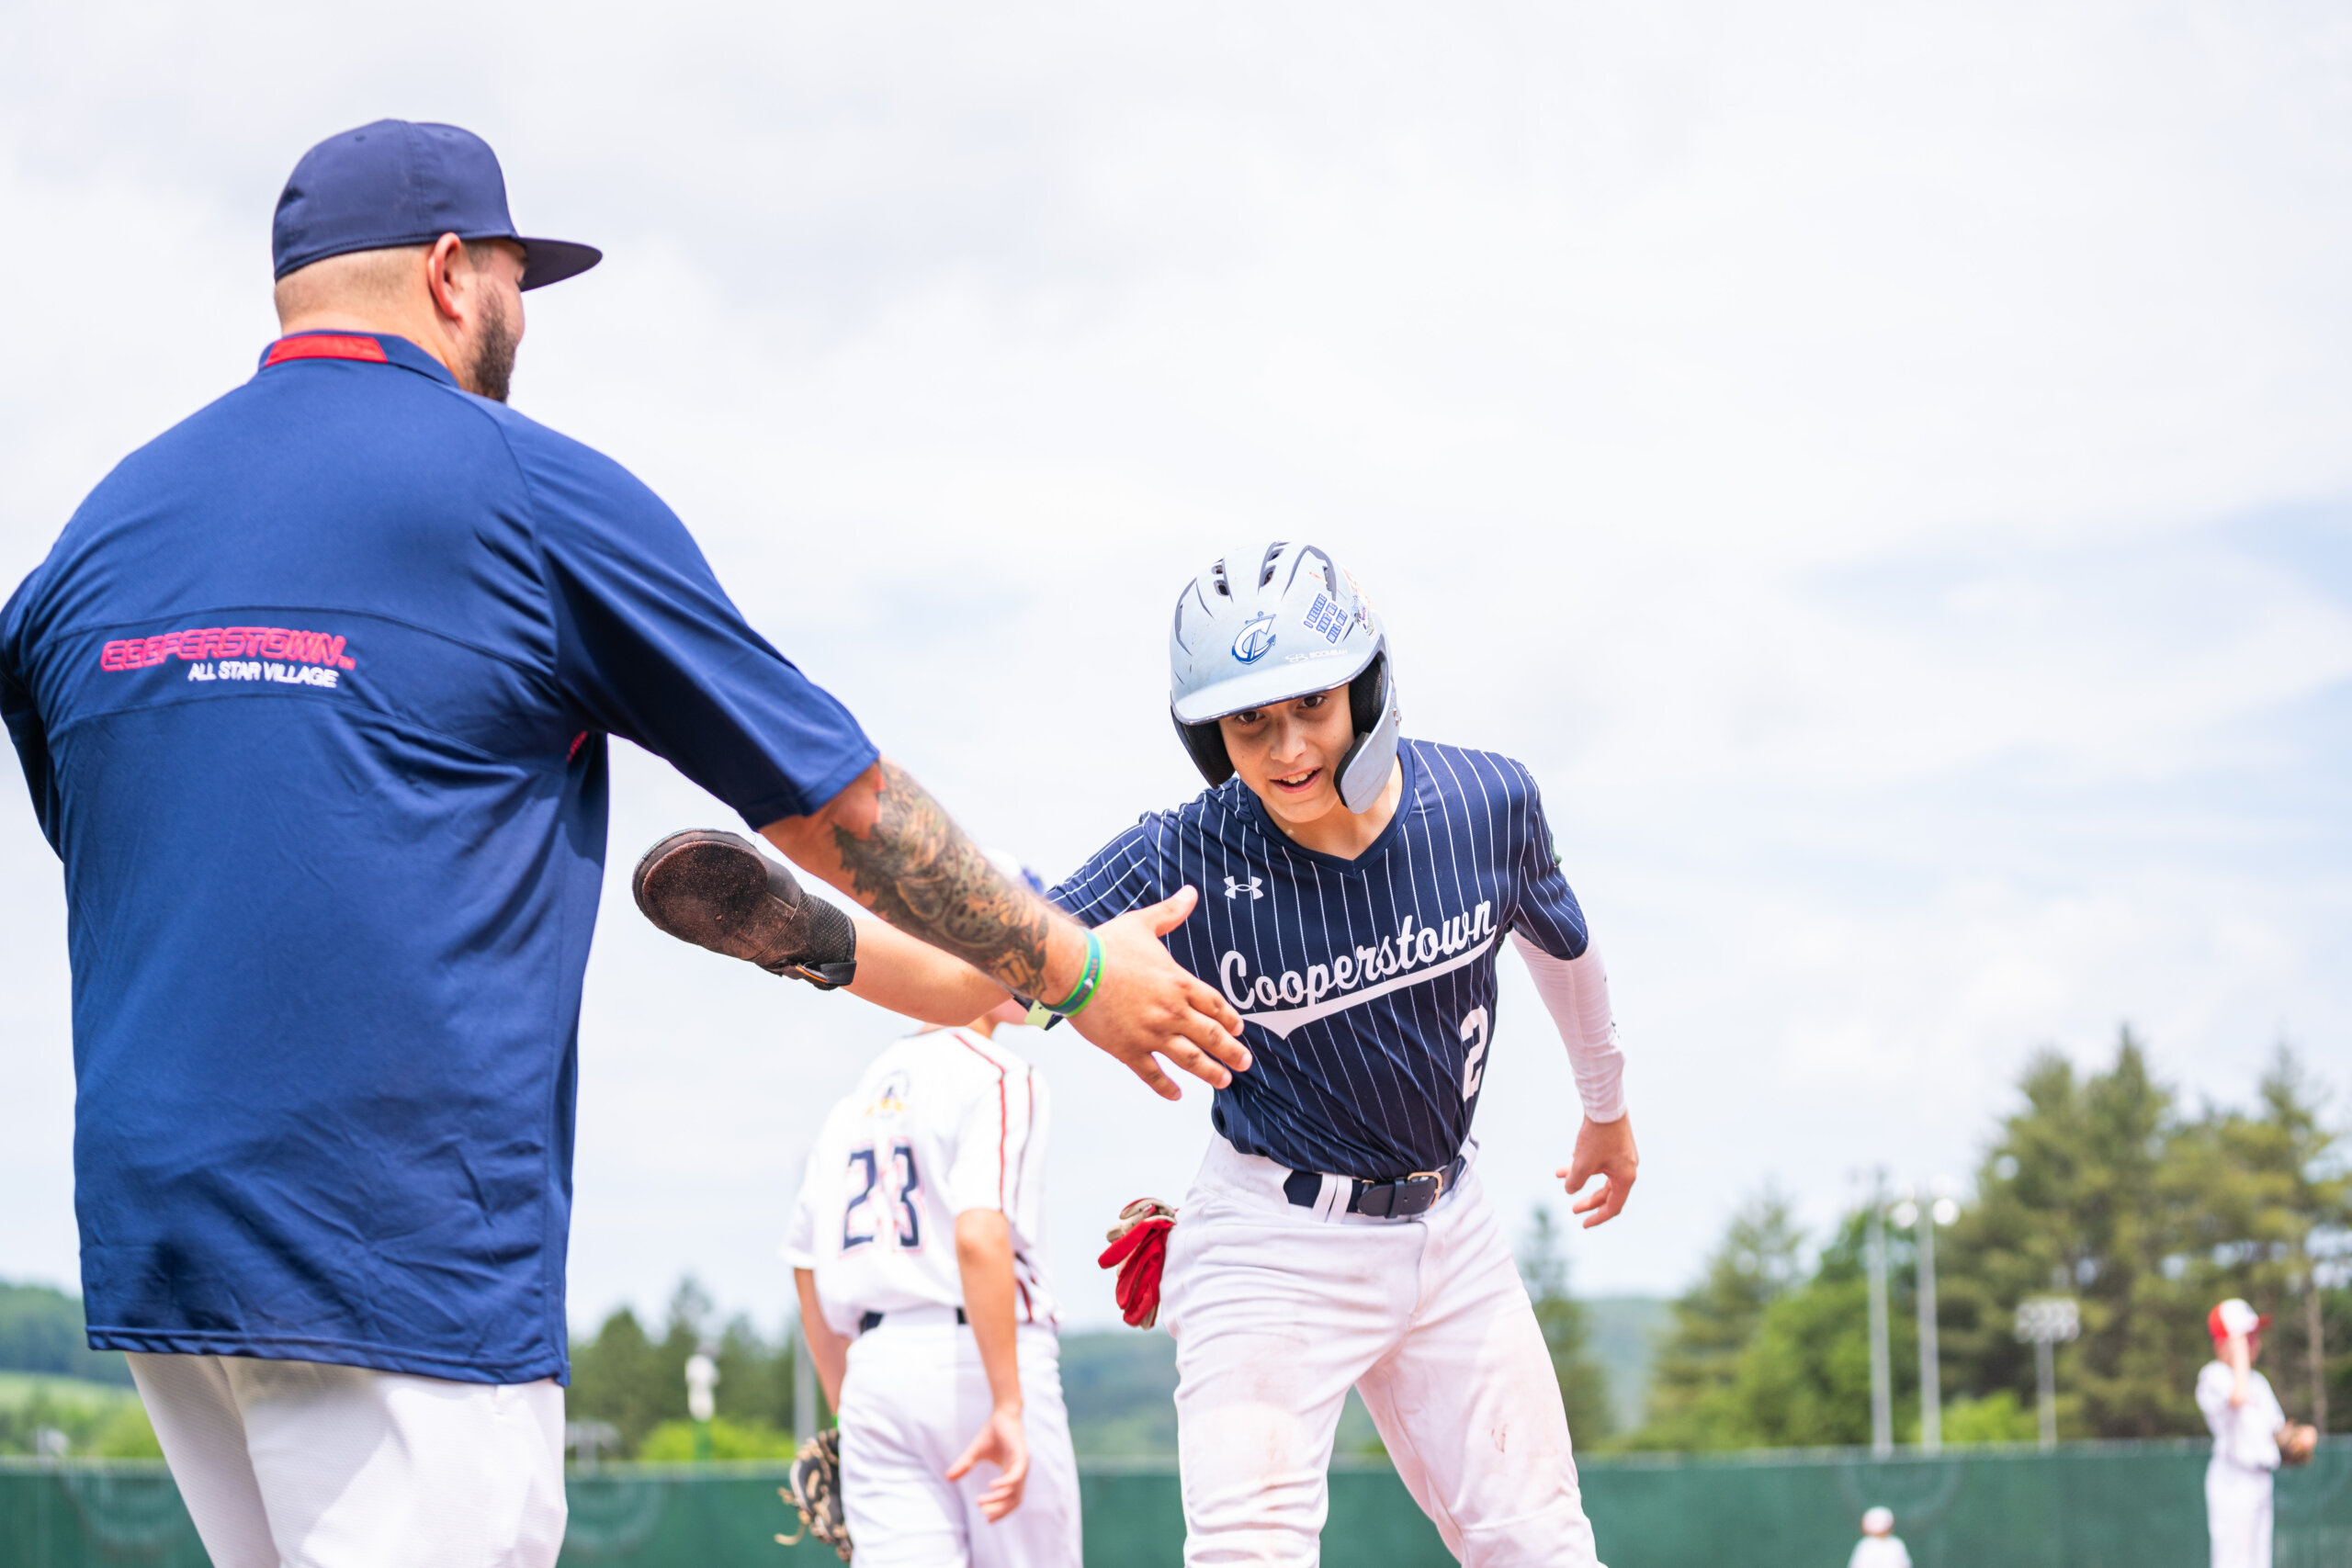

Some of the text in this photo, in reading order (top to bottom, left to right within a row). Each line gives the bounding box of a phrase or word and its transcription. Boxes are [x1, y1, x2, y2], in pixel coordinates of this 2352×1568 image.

[1306, 592, 1328, 623] BELIEVE
[187, 660, 340, 688] ALL STAR VILLAGE
[1220, 899, 1498, 1010] Cooperstown
[1460, 1004, 1488, 1103] 2
[840, 1139, 924, 1255] 23
